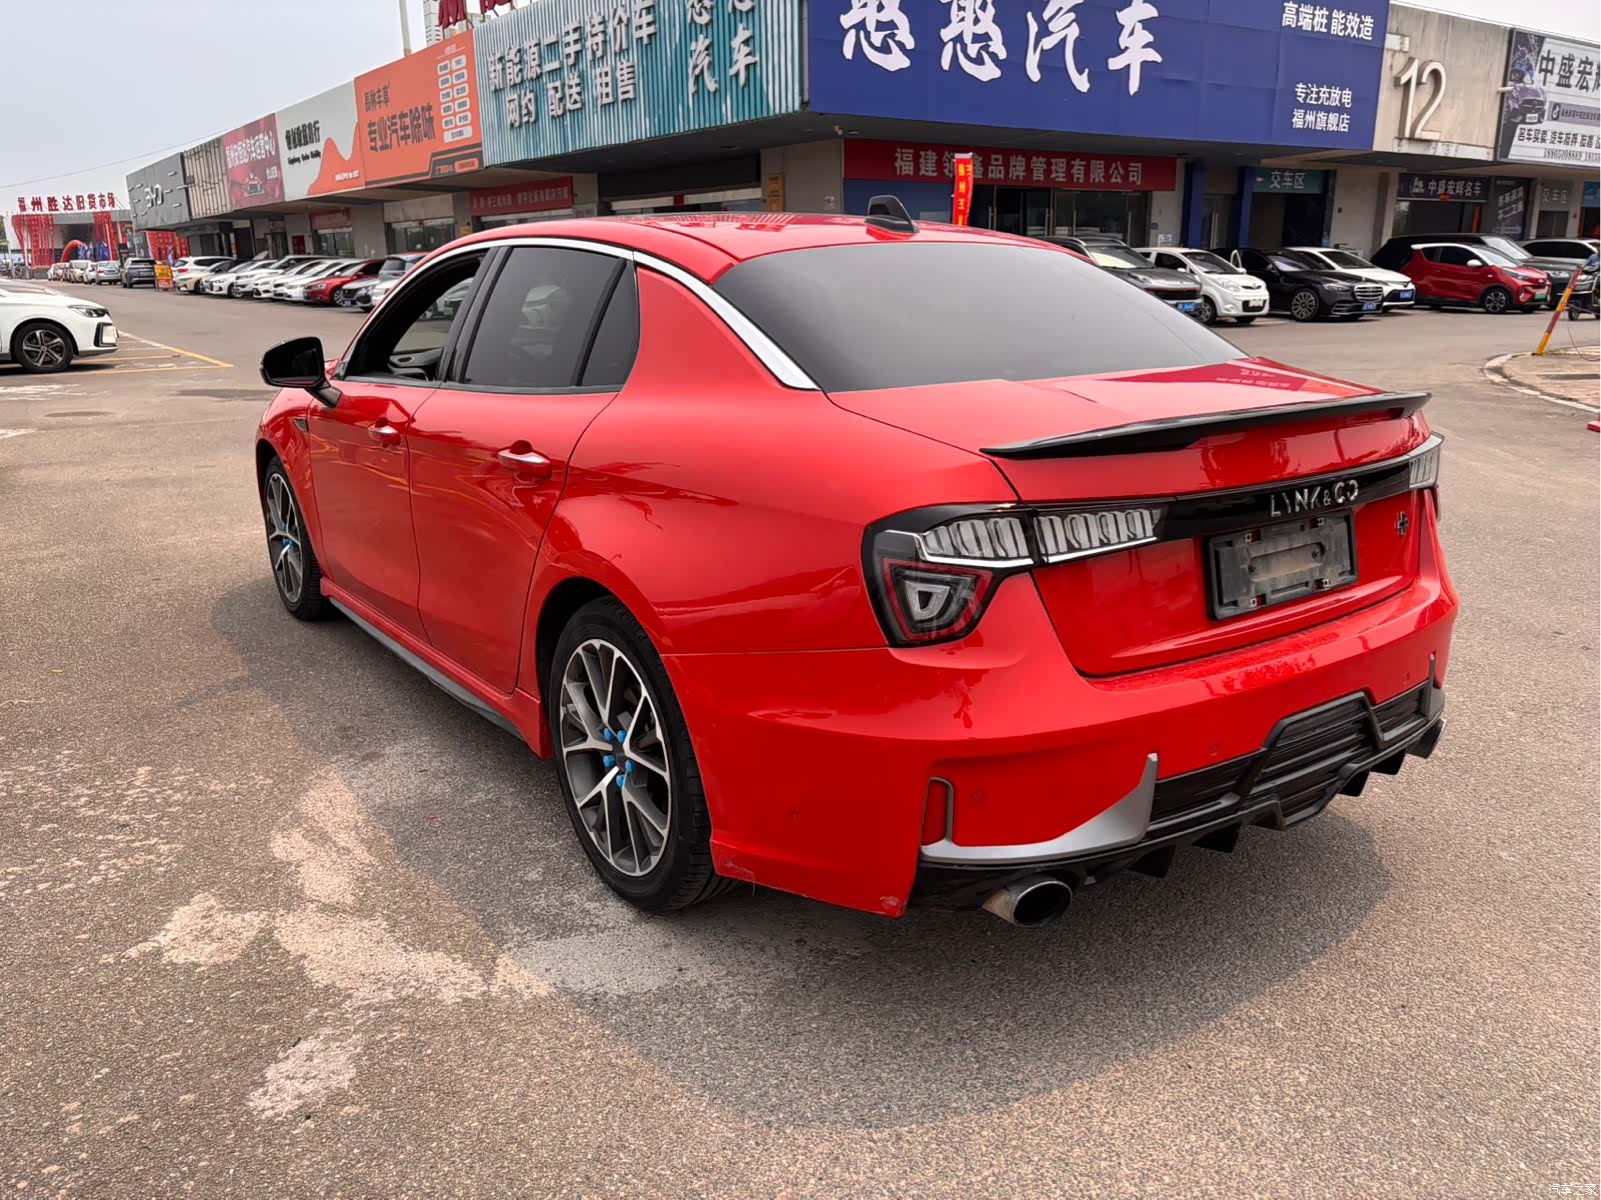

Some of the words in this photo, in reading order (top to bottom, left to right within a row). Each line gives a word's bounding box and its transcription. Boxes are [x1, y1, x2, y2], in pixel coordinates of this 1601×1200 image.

[1282, 1, 1329, 33] 高端桩
[1330, 9, 1374, 41] 能效造
[487, 0, 658, 92] 新能源二手特价车
[688, 23, 759, 94] 汽车
[505, 89, 536, 128] 网约
[547, 72, 583, 118] 配送
[596, 61, 636, 105] 租售
[1295, 82, 1352, 108] 专注充放电
[1397, 57, 1447, 140] 12
[367, 102, 436, 152] 专业汽车除味
[1292, 108, 1350, 132] 福州旗舰店
[1269, 170, 1305, 189] 交车区
[18, 192, 116, 212] 福州胜达旧货市场
[1270, 479, 1359, 518] LYNK&CO
